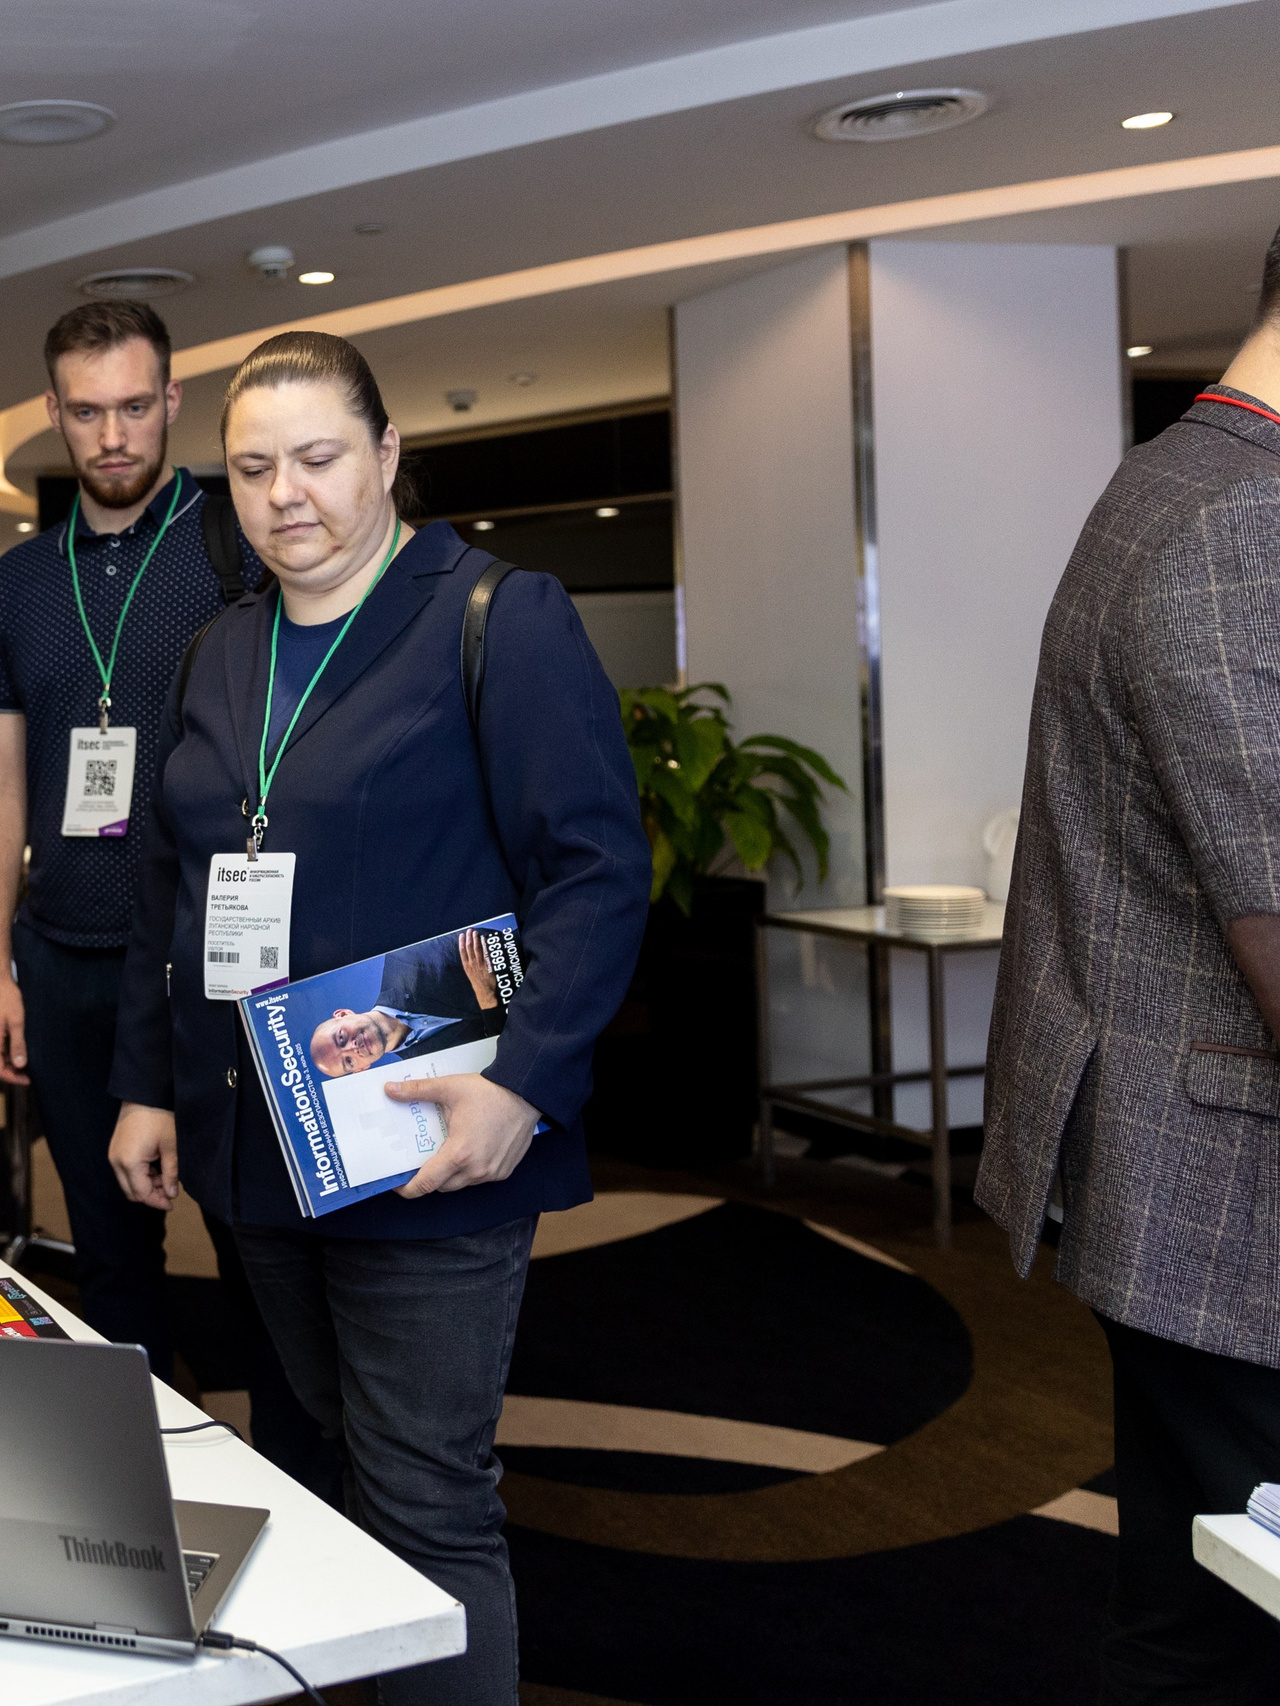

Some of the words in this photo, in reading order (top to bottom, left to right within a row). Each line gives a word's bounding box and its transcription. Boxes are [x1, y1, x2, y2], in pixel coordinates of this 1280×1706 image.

[217, 867, 247, 882] itsec
[486, 931, 507, 971] 56939:
[255, 993, 289, 1009] www.itsec.ru
[496, 974, 513, 1004] ГОСТ
[266, 1005, 340, 1197] InformationSecurity
[308, 1080, 328, 1128] БЕЗОПАСНОСТЬ
[323, 1128, 348, 1189] ИНФОРМАЦИОННАЯ
[59, 1534, 166, 1572] ThinkBook
